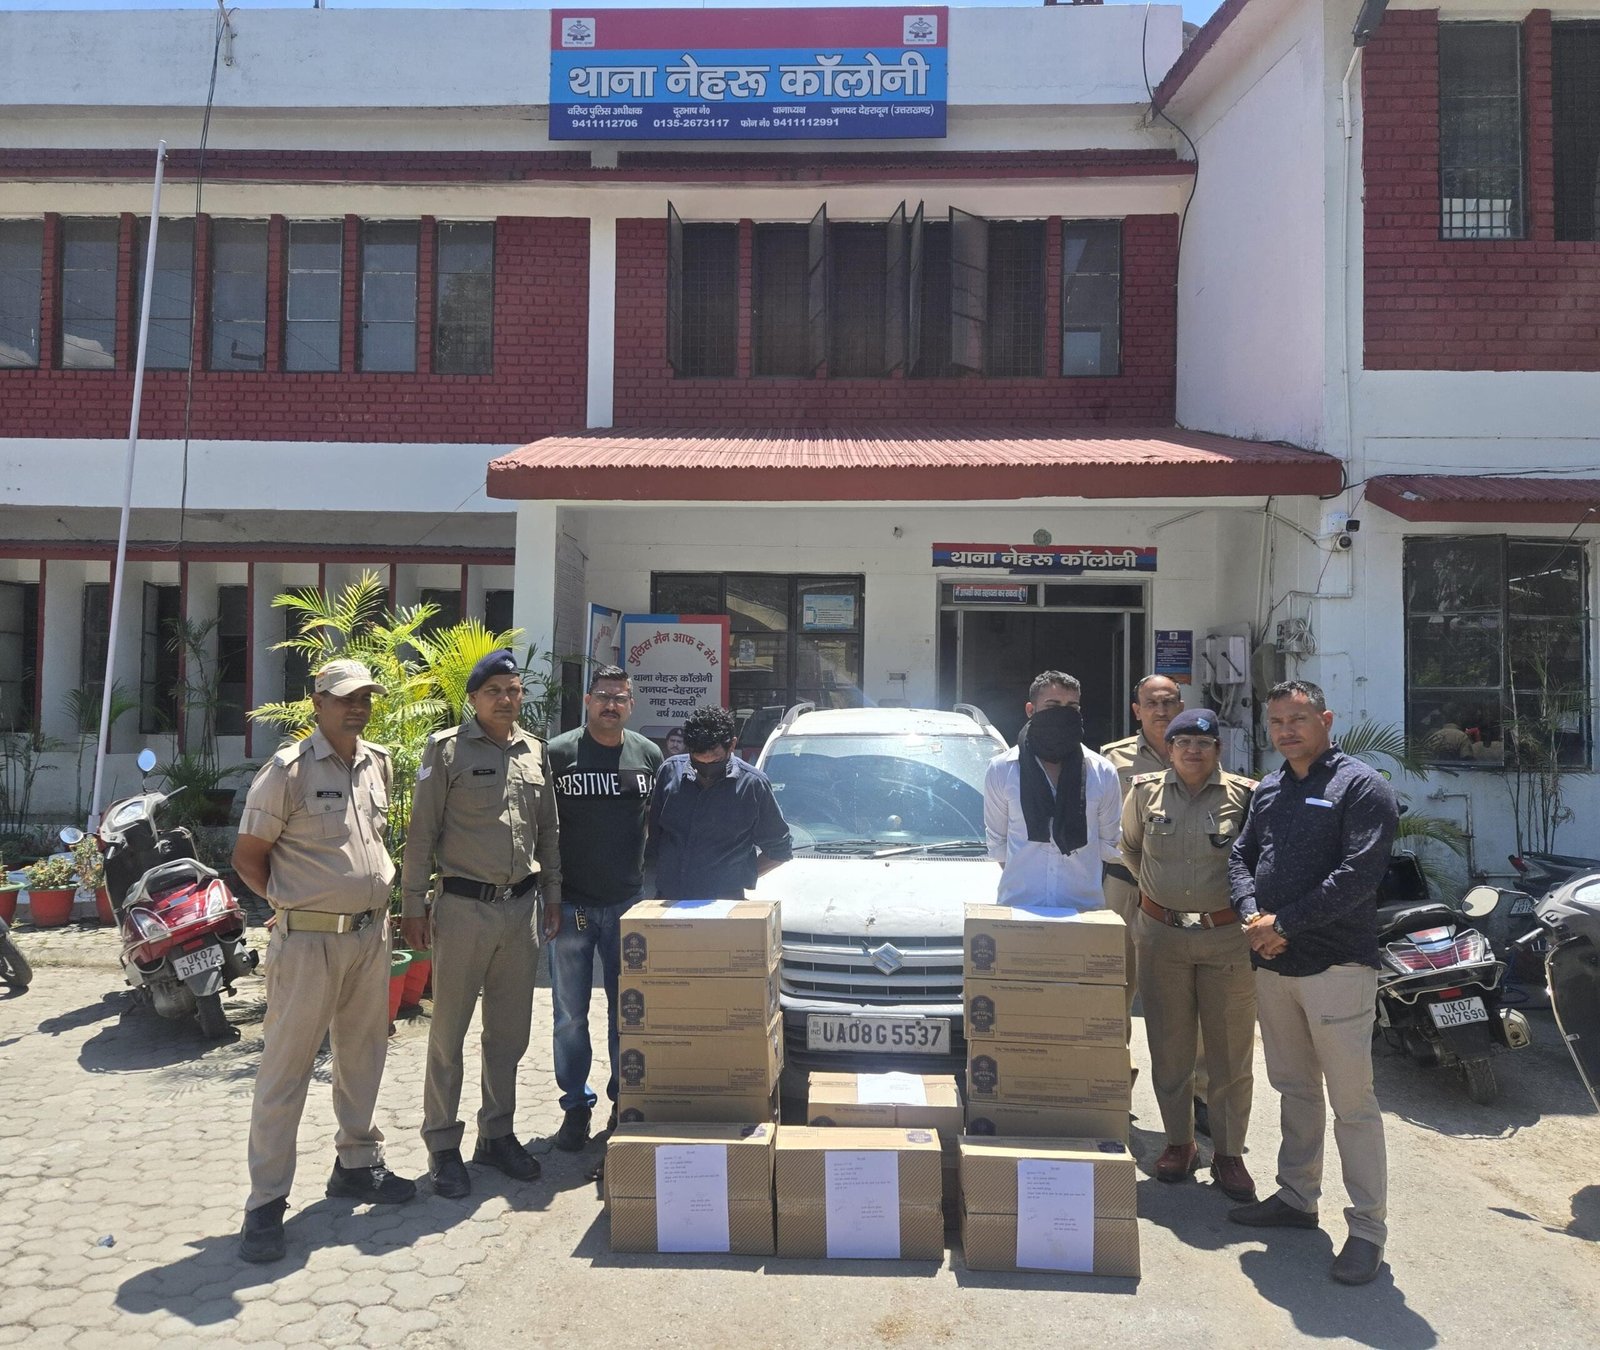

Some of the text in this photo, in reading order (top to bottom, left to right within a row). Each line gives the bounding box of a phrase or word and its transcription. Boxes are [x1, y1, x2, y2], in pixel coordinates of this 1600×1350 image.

[569, 50, 930, 101] थाना नेहरू कॉलोनी
[589, 105, 611, 118] पुलिस
[612, 105, 643, 115] अधीक्षक
[673, 106, 698, 118] दूरभाष
[830, 106, 857, 115] जनपद
[859, 105, 888, 117] देहरादून
[572, 119, 638, 128] 9411112706
[653, 119, 729, 128] 0135-2673117
[740, 118, 757, 128] फोन
[773, 118, 839, 127] 9411112991
[951, 546, 1138, 568] थाना नेहरू कॉलोनी
[628, 639, 653, 667] पुलिस
[672, 633, 696, 646] आफ
[696, 640, 705, 652] द
[633, 672, 713, 683] थाना नेहरू कॉलोनी
[649, 698, 666, 707] माह
[656, 707, 670, 717] वर्ष
[186, 947, 215, 965] UK07
[1442, 1000, 1471, 1014] UK07
